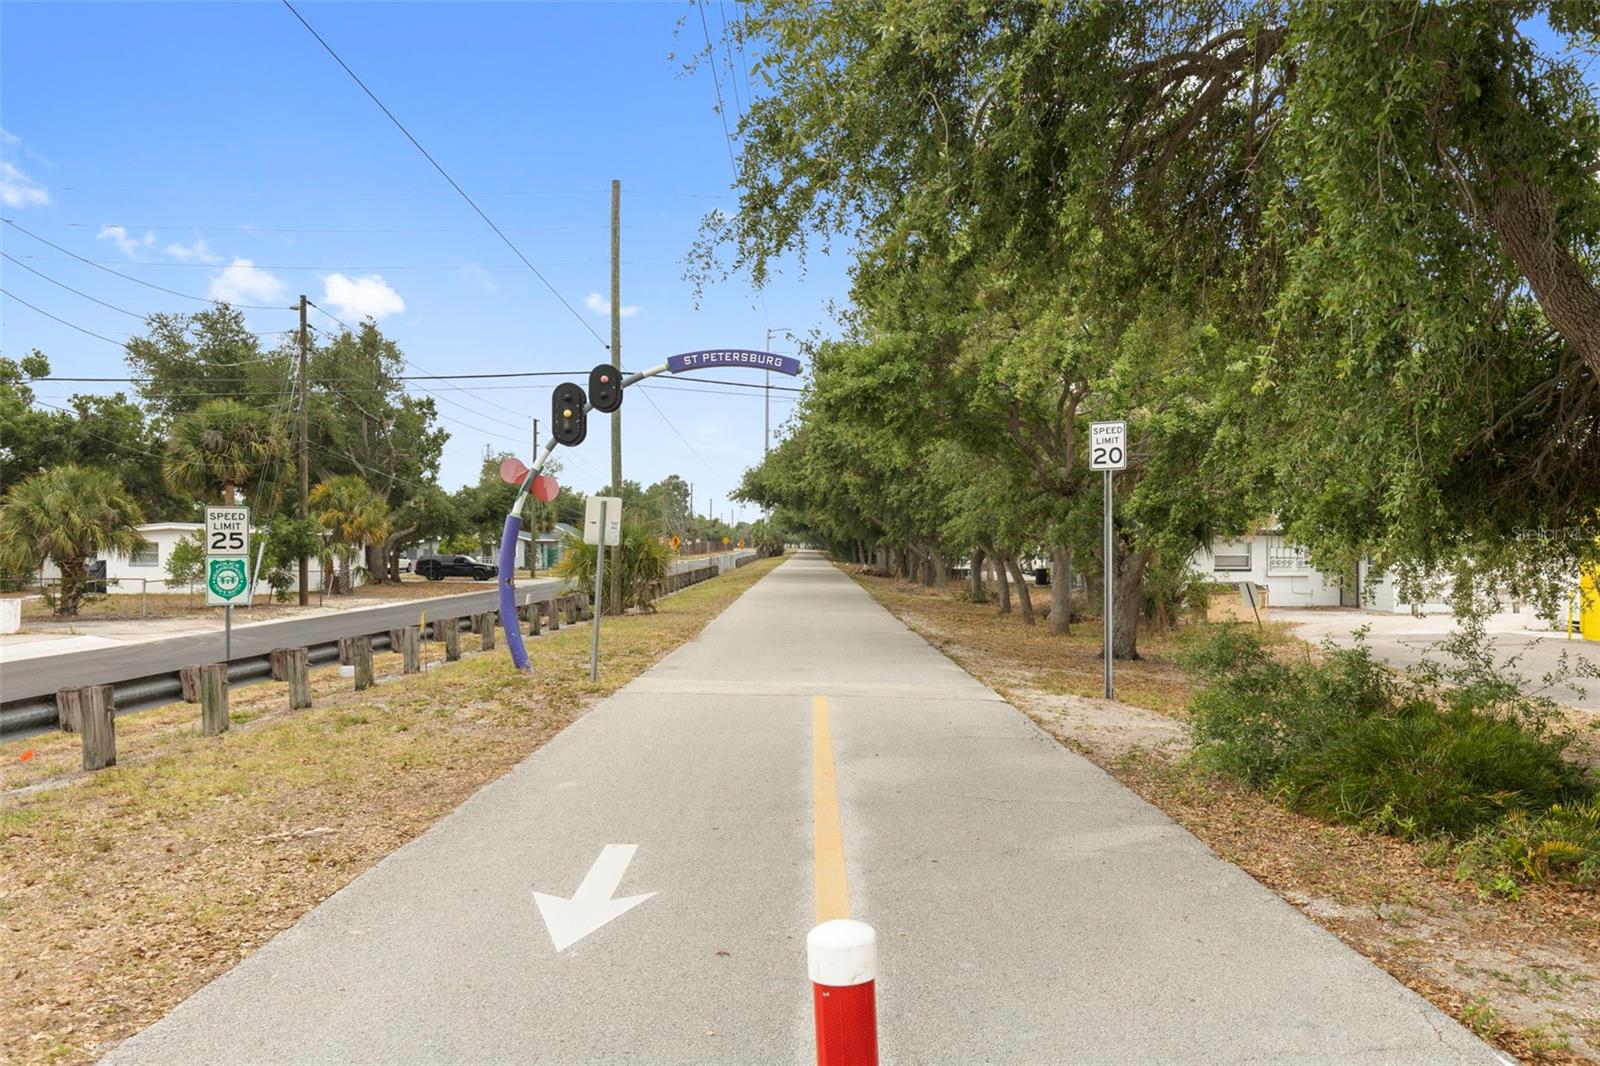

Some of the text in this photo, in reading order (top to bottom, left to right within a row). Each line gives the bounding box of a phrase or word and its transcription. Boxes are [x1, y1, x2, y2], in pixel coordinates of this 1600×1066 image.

[683, 352, 783, 367] ST PETERSBURG
[1093, 426, 1123, 435] SPEED
[1096, 437, 1119, 445] LIMIT
[1093, 446, 1123, 465] 20
[209, 512, 246, 521] SPEED
[213, 522, 241, 530] LIMIT
[211, 532, 244, 550] 25
